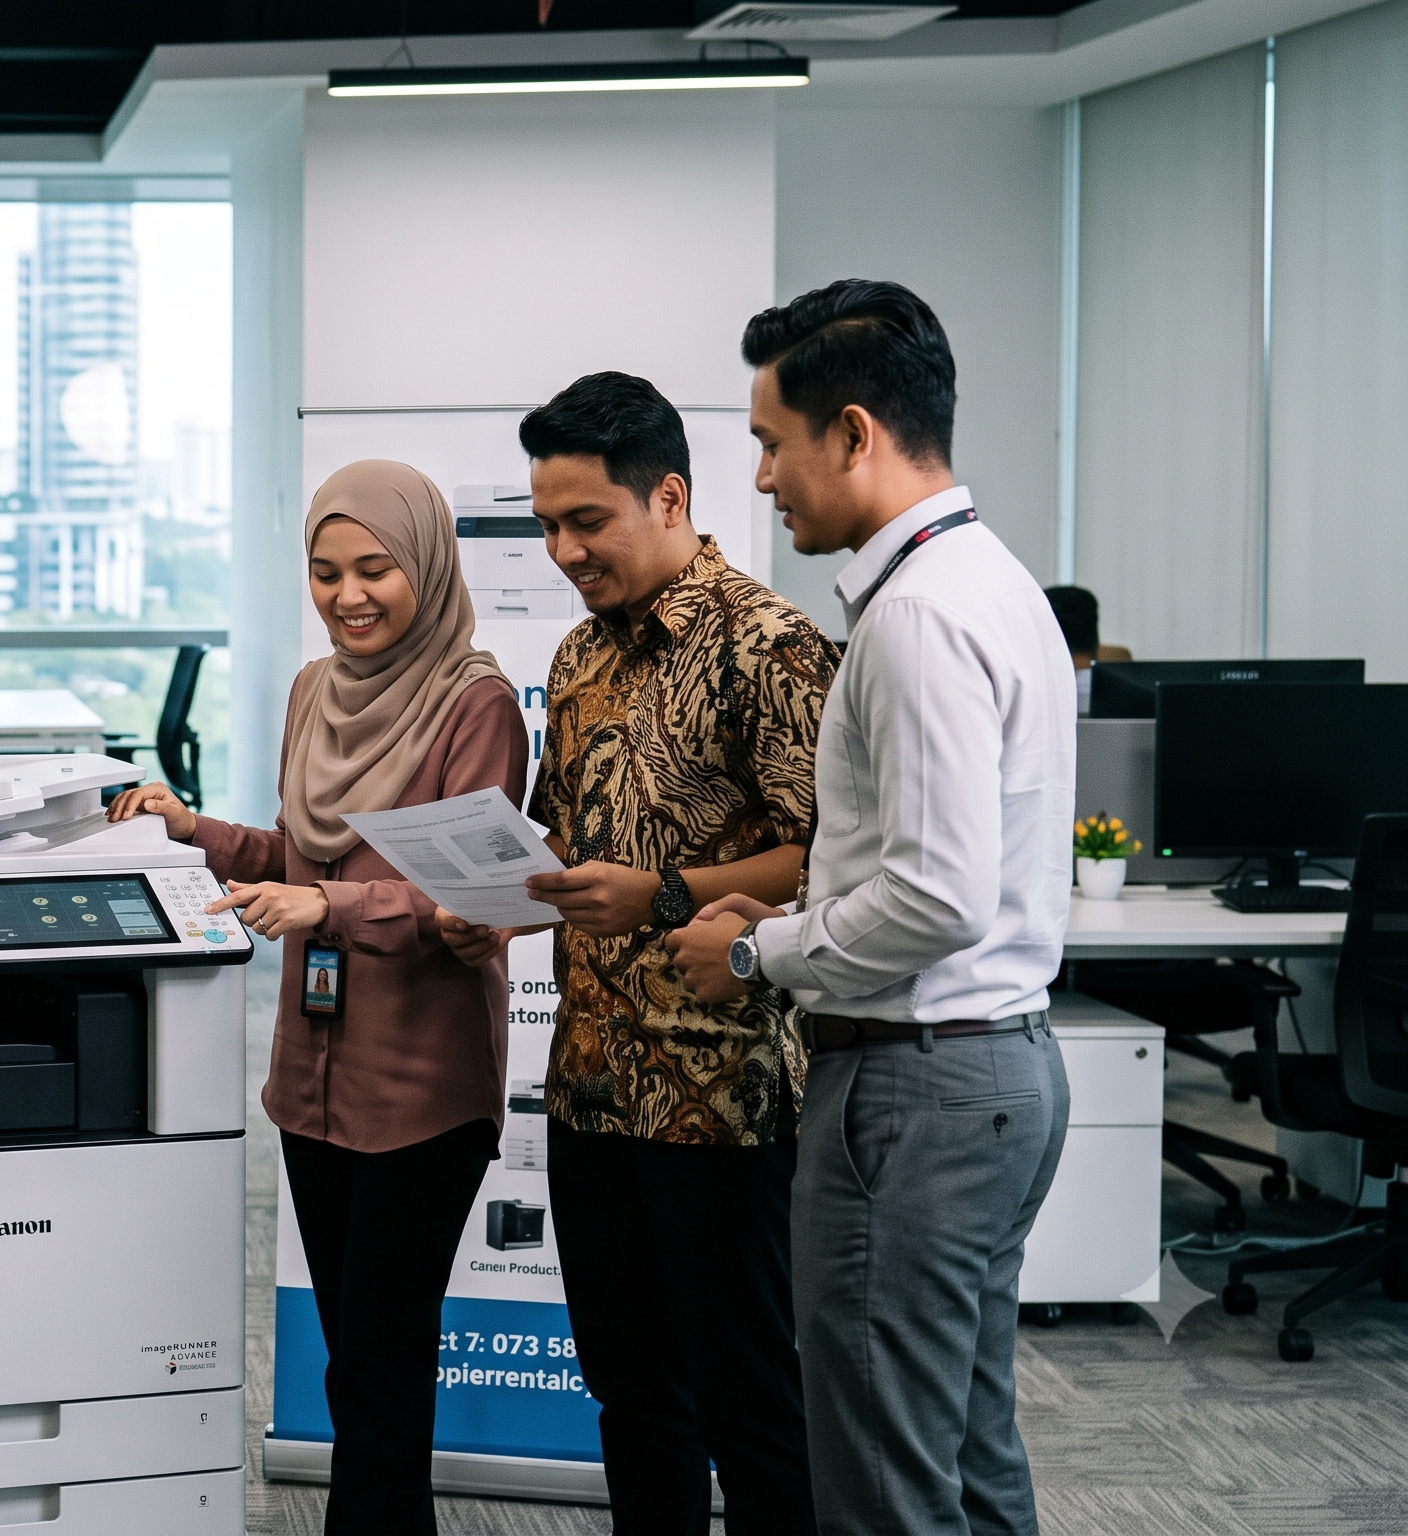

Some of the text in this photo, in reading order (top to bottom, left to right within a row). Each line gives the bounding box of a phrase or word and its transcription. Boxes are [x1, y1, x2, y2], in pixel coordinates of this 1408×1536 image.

[465, 1332, 485, 1352] 7:
[492, 1333, 539, 1356] 073
[547, 1337, 577, 1358] 58
